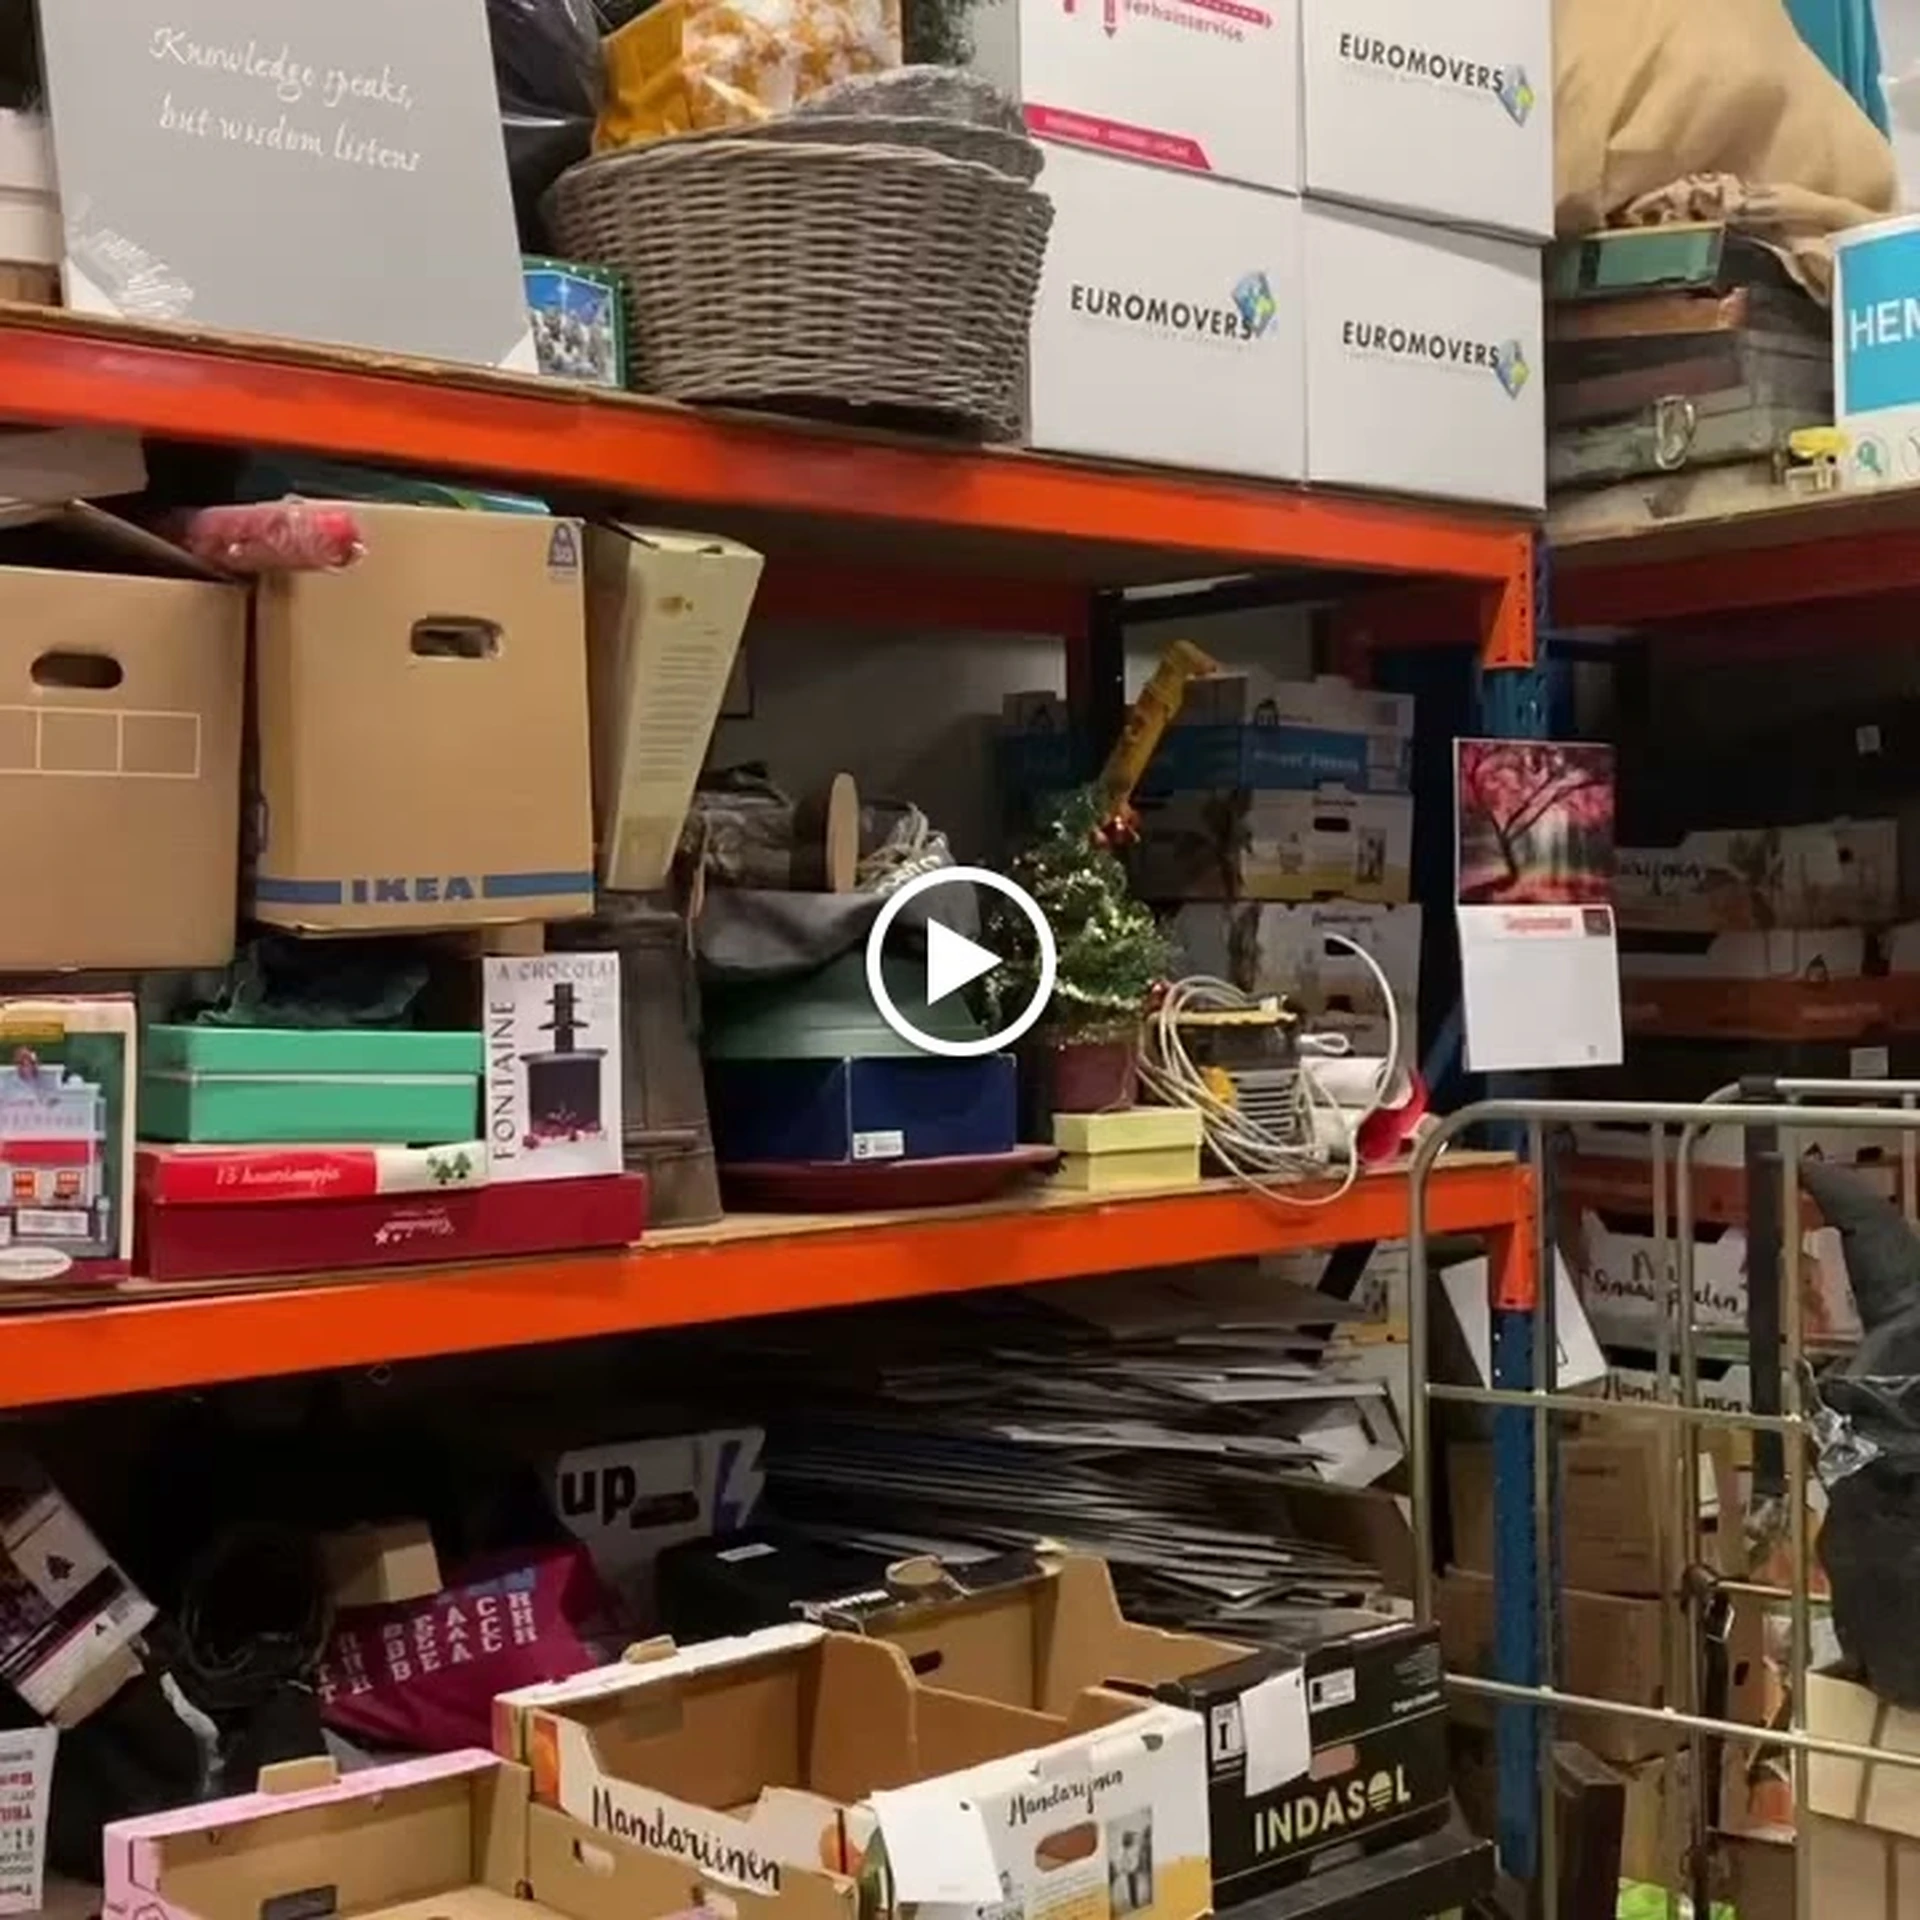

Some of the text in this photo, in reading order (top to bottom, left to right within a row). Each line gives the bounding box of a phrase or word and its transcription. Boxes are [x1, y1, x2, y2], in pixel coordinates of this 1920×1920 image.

[149, 28, 412, 110] Knowledge speaks,
[1339, 33, 1504, 93] EUROMOVERS
[159, 90, 420, 171] but wisdom listens
[1070, 284, 1253, 342] EUROMOVERS
[1342, 320, 1499, 370] EUROMOVERS
[352, 877, 475, 902] IKEA
[490, 1000, 516, 1161] FONTAINE
[562, 1466, 635, 1526] up
